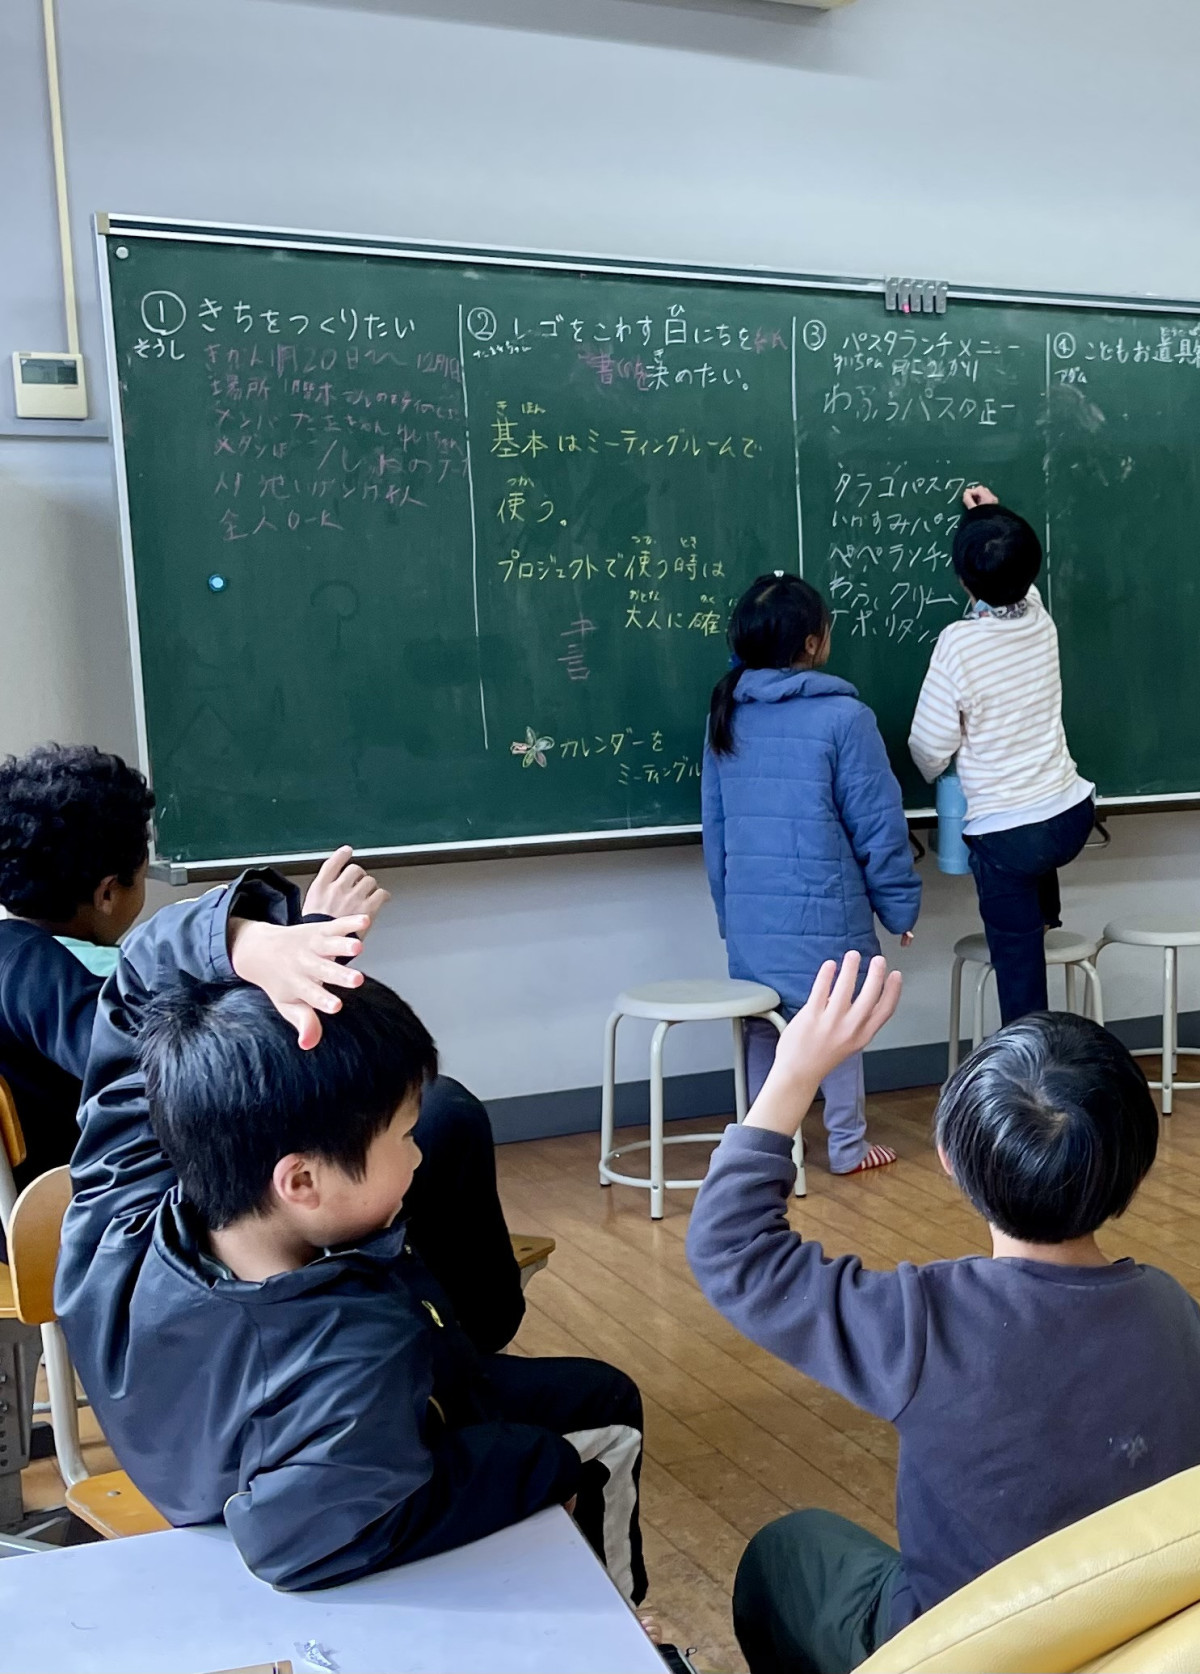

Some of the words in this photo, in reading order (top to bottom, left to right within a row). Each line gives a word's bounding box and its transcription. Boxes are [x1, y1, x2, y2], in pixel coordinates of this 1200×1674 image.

[199, 298, 416, 341] きちをつくりたい
[490, 414, 764, 459] 基本はミーティングルームで
[497, 549, 726, 584] プロジェクトで使う時は
[624, 604, 733, 637] 大人に確
[829, 608, 939, 644] ナポリタン
[560, 727, 664, 759] カレンダーを
